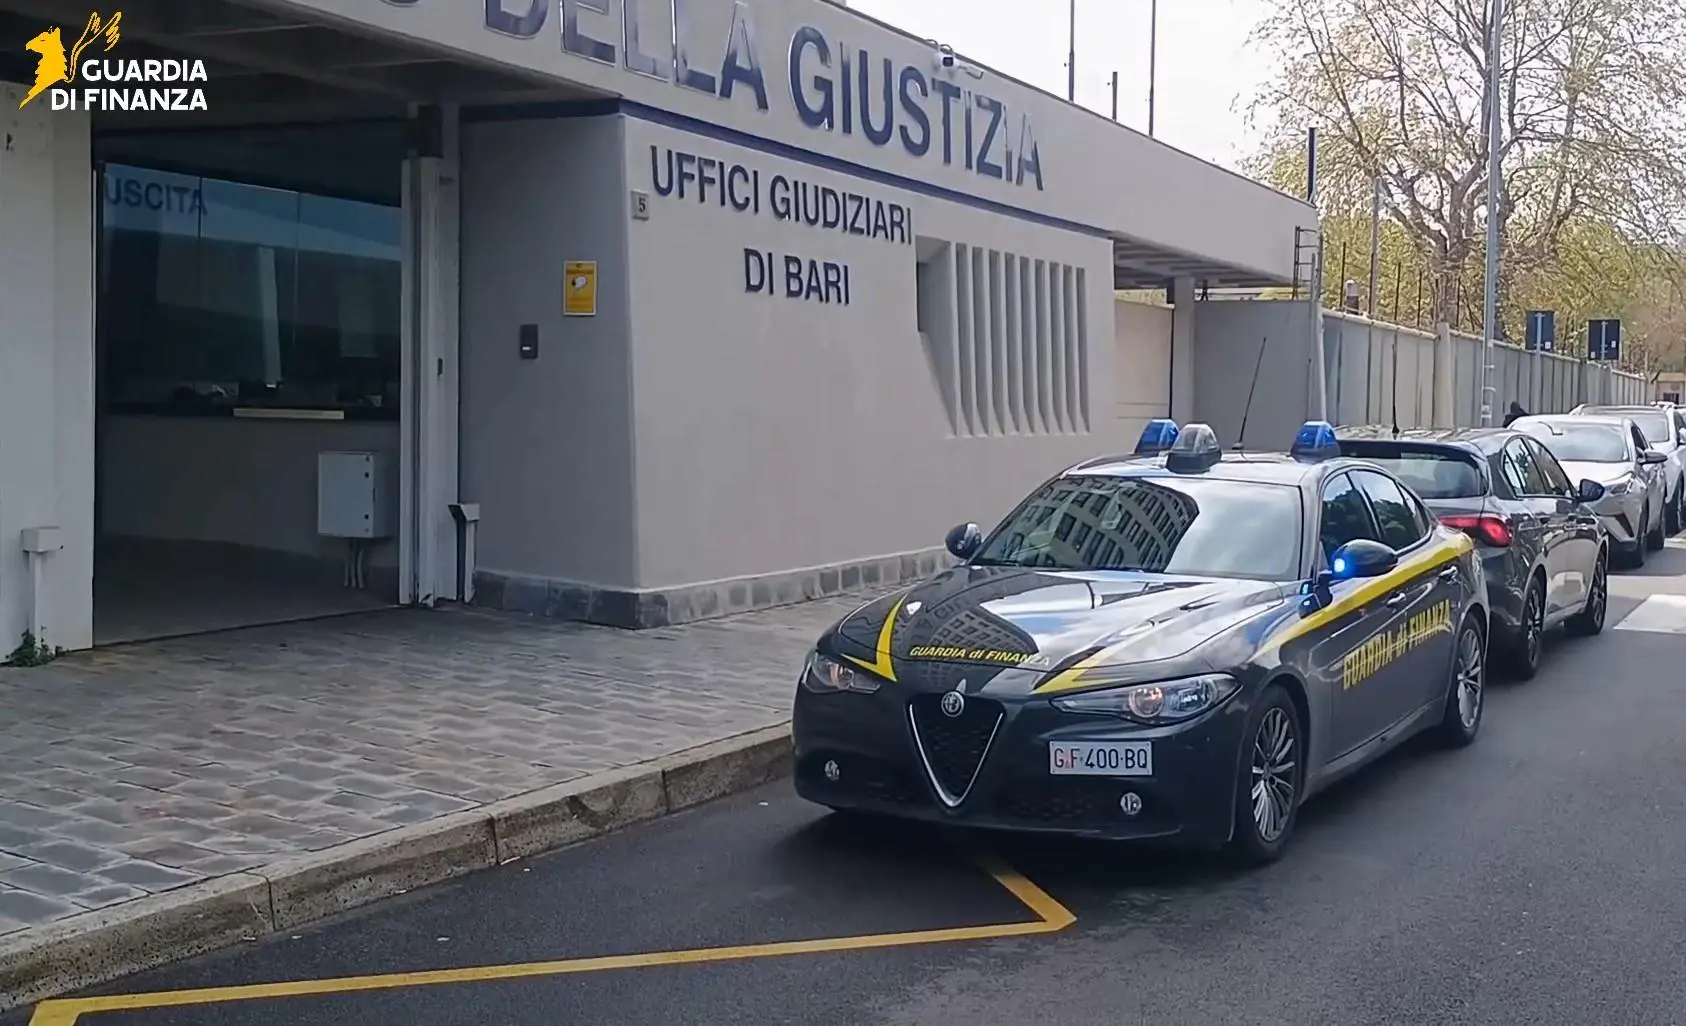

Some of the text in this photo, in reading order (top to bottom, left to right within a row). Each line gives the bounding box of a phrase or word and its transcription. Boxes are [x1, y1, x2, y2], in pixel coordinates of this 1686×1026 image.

[787, 26, 1044, 191] GIUSTIZIA
[104, 177, 208, 216] USCITA
[637, 197, 646, 213] 5
[650, 145, 912, 245] UFFICI GIUDIZIARI
[744, 248, 850, 305] DI BARI
[909, 646, 966, 658] GUARDIA
[985, 650, 1050, 666] FINANZA
[1343, 630, 1392, 690] GUARDIA
[1409, 598, 1451, 651] FINANZA
